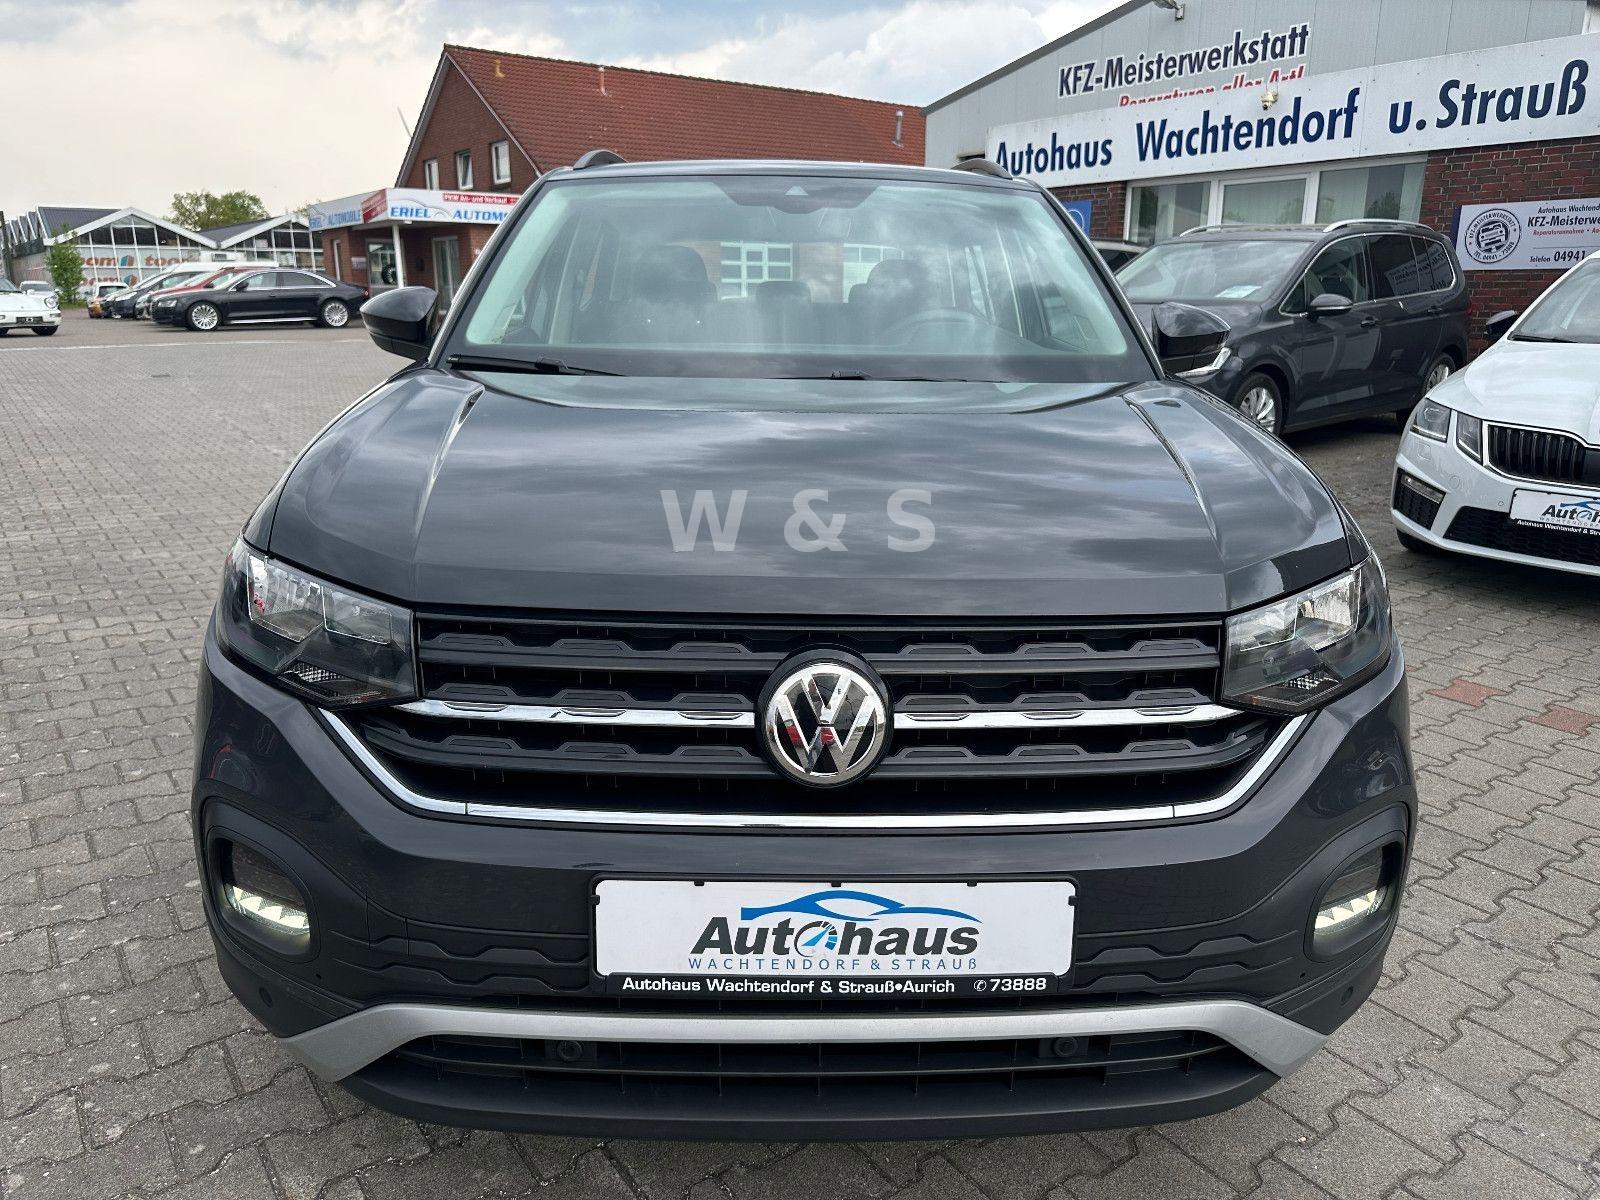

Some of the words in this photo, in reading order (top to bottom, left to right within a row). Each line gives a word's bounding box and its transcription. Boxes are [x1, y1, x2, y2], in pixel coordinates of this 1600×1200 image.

[1059, 24, 1309, 97] KFZ-Meisterwerkstatt
[996, 132, 1113, 176] Autohaus
[1136, 87, 1361, 162] Wachtendorf
[1389, 100, 1427, 134] u.
[1435, 59, 1589, 129] Strauß
[390, 206, 431, 219] ERIEL
[1538, 205, 1567, 214] Autohaus
[1553, 250, 1586, 262] 04941
[1544, 523, 1582, 533] Wachtendorf
[690, 916, 980, 957] Autohaus
[689, 958, 860, 970] WACHTENDORF
[870, 959, 880, 970] &
[622, 977, 701, 991] Autohaus
[706, 978, 815, 993] Wachtendorf
[820, 981, 833, 993] &
[990, 977, 1047, 992] 73888
